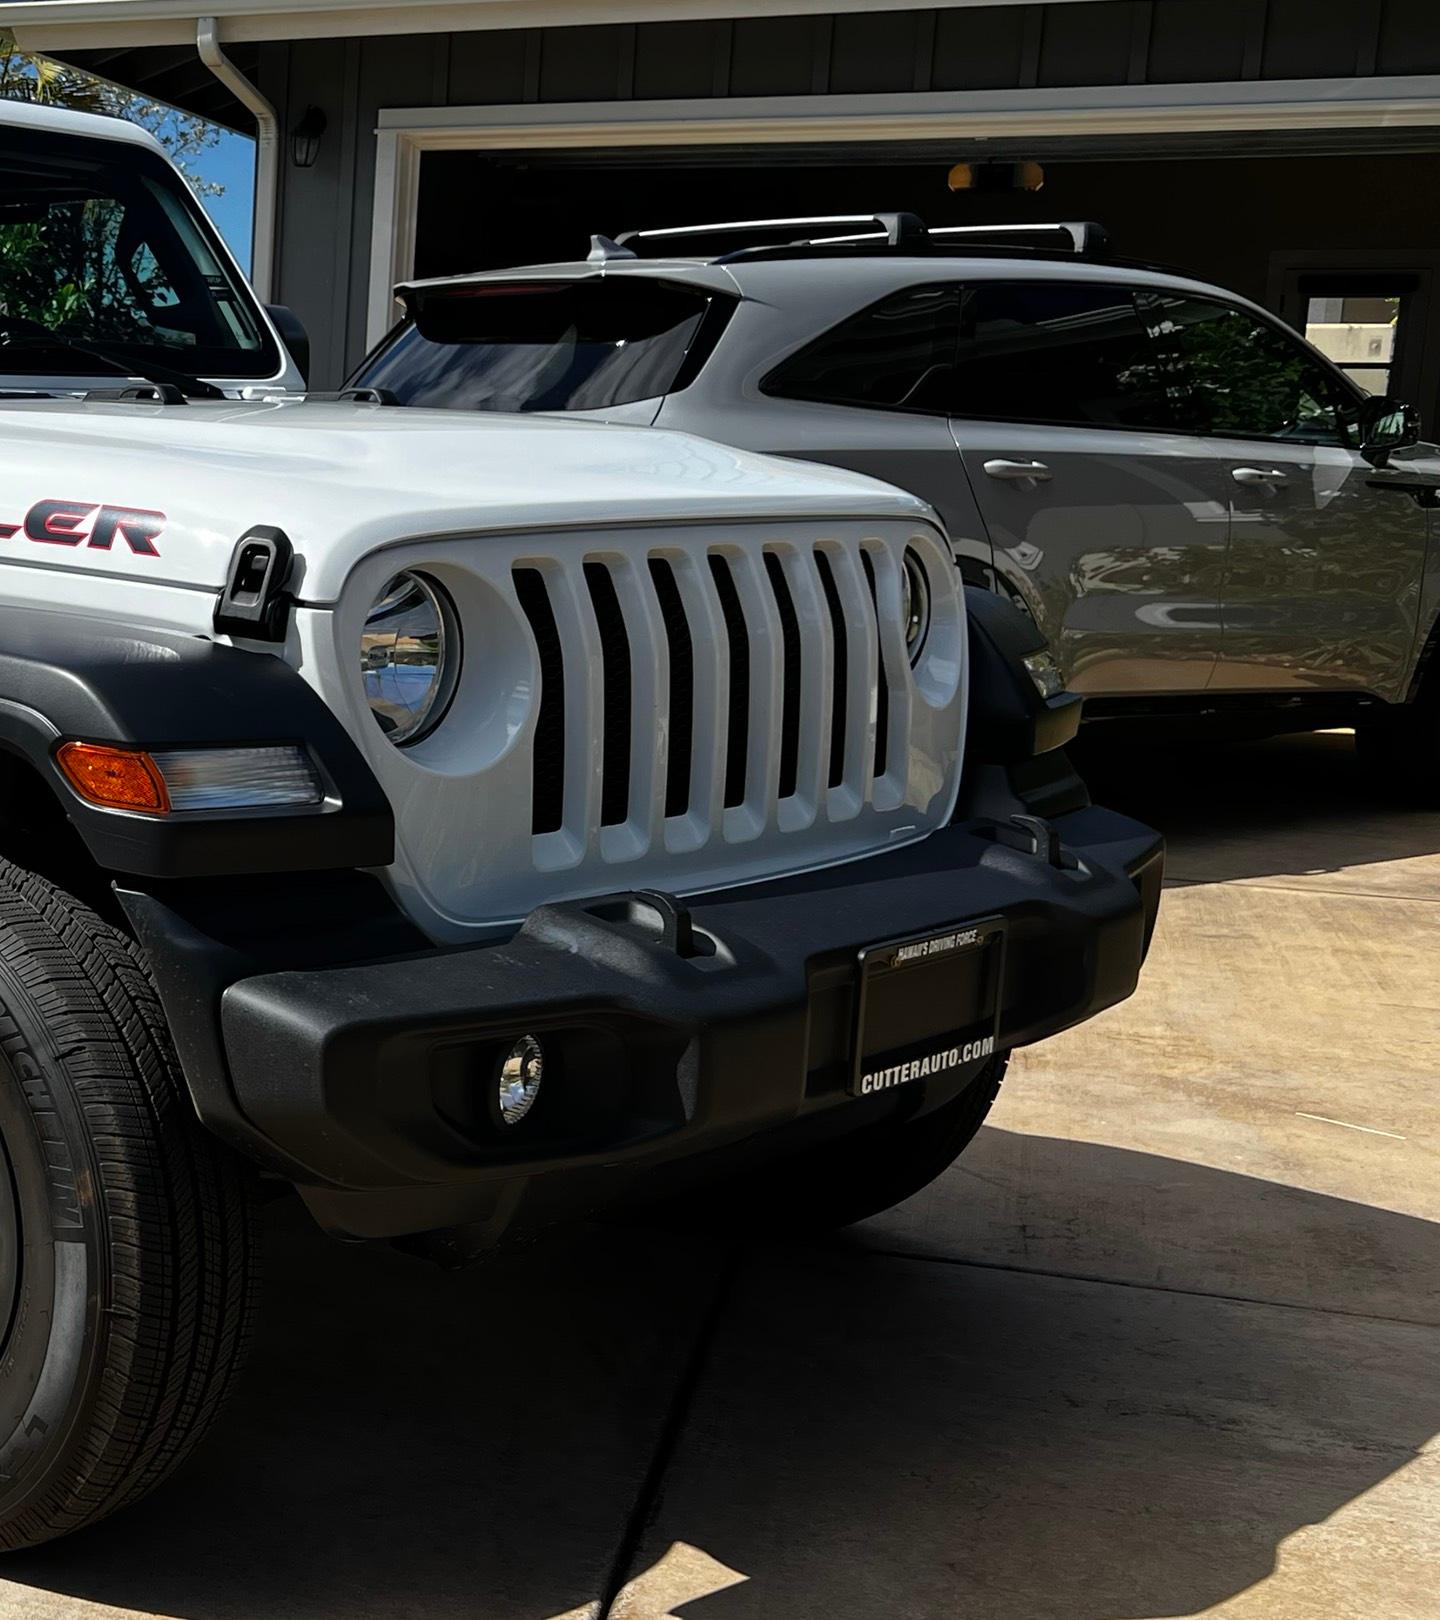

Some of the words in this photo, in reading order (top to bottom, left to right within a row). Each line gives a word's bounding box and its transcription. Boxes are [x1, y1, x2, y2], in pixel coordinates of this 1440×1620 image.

[928, 934, 956, 954] DRIVING
[956, 928, 978, 947] FORCE
[861, 1035, 995, 1095] CUTTERAUTO.COM
